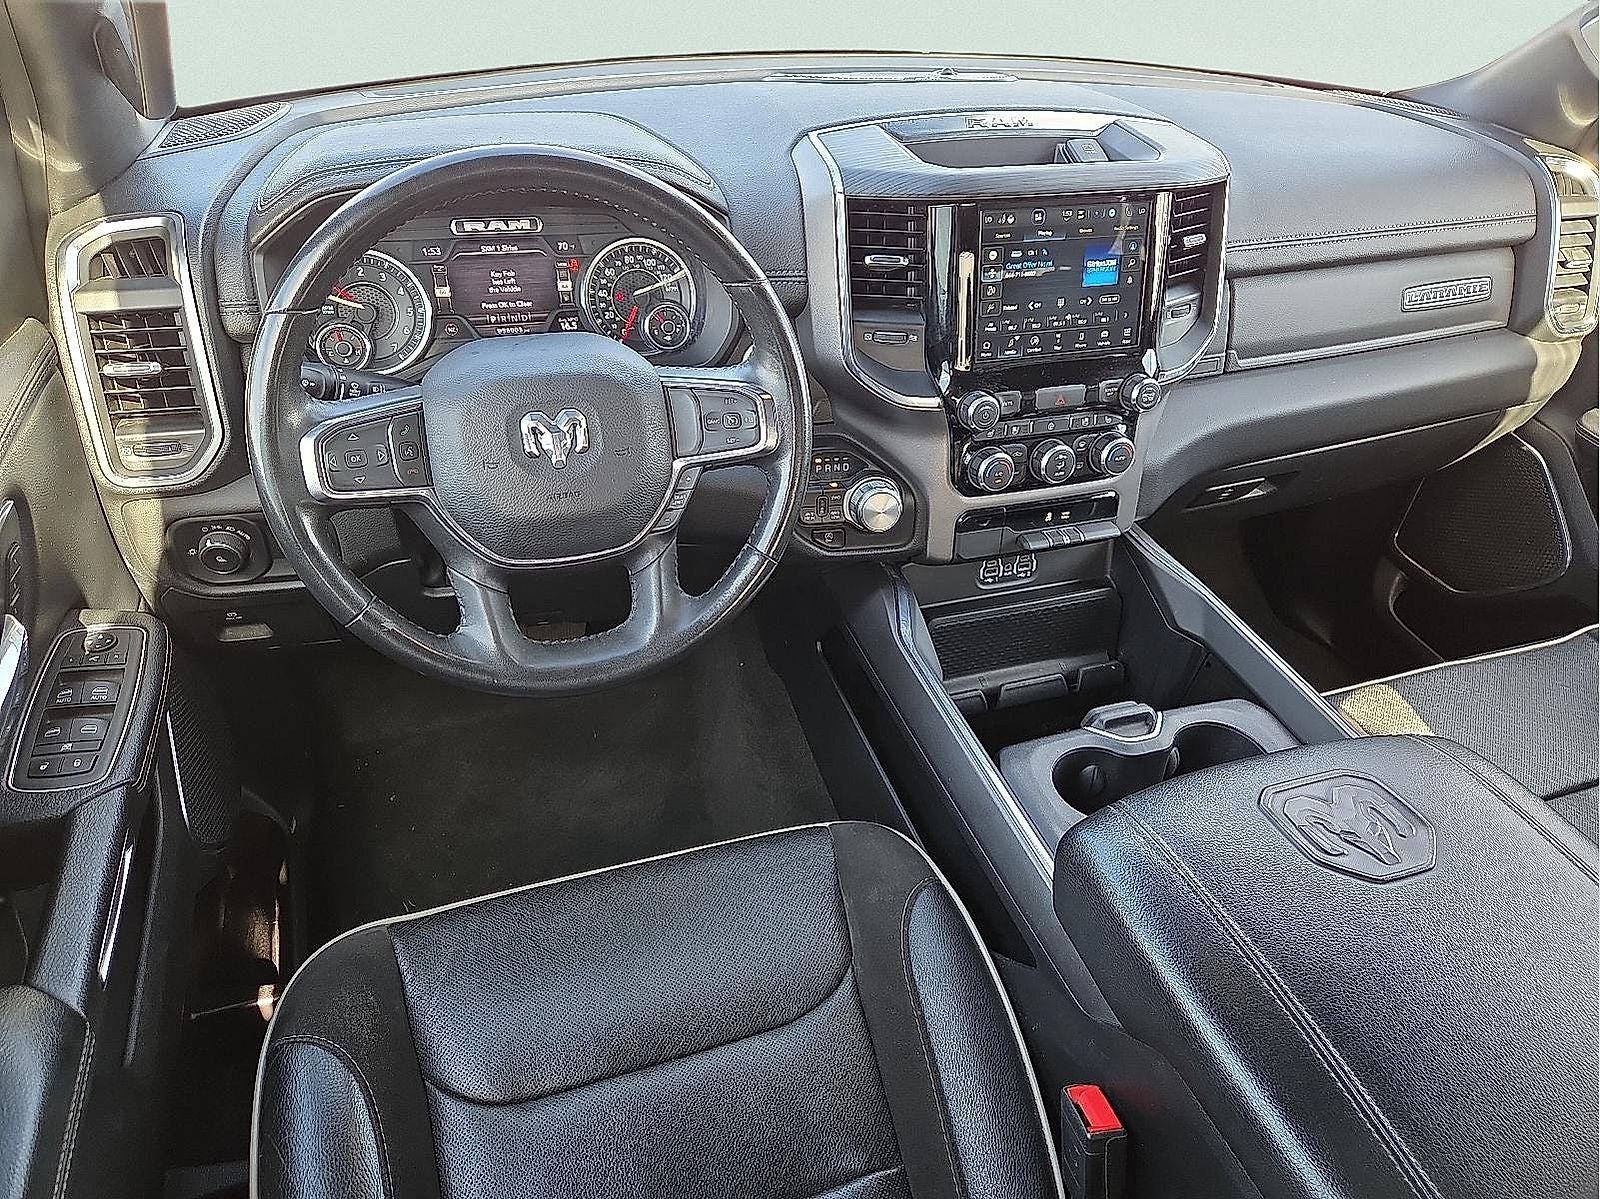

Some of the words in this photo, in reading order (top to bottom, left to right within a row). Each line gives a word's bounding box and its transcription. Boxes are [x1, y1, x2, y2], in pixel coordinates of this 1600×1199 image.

[965, 116, 1033, 128] RAM
[463, 220, 531, 232] RAM
[557, 242, 568, 251] 70
[422, 247, 441, 256] 1:53
[356, 267, 364, 276] 2
[379, 272, 387, 281] 3
[397, 287, 405, 296] 4
[1406, 282, 1489, 303] LARAMIE
[407, 310, 414, 318] 5
[403, 326, 410, 335] 6
[390, 343, 398, 353] 7
[350, 455, 361, 463] OK
[816, 465, 822, 473] P
[825, 464, 831, 472] R
[833, 463, 840, 471] N
[843, 463, 849, 471] D
[236, 530, 251, 540] AUTO
